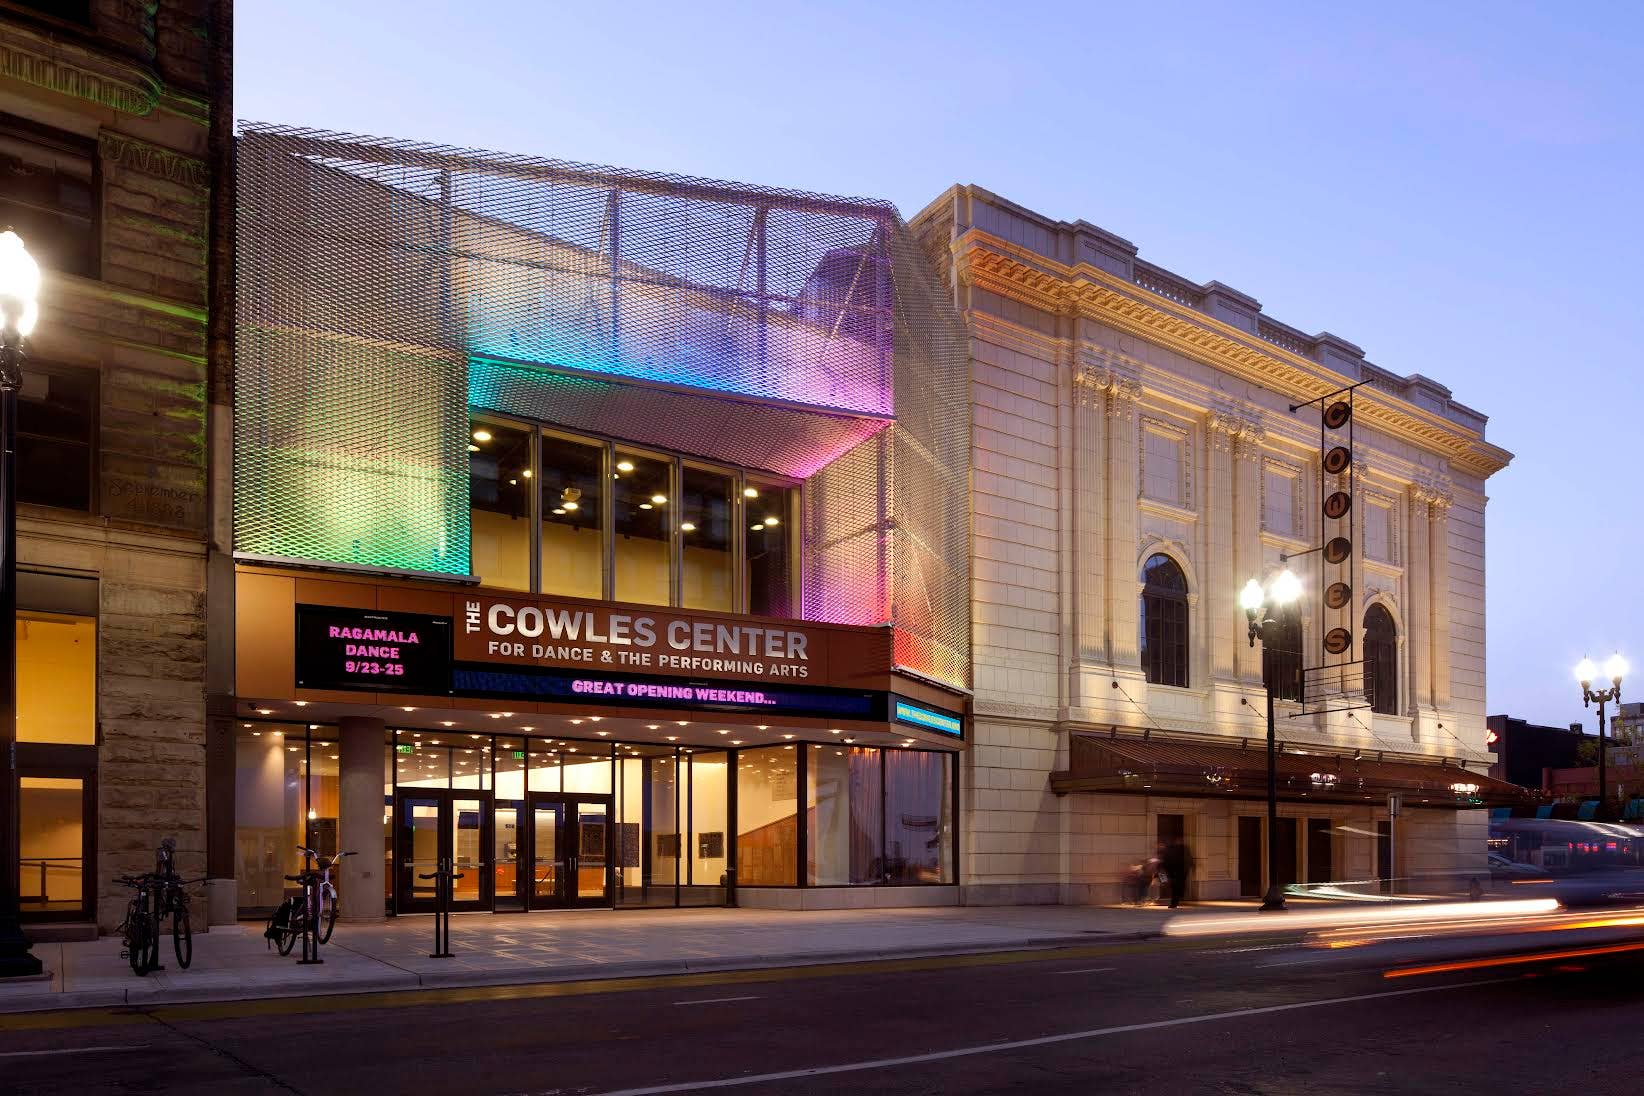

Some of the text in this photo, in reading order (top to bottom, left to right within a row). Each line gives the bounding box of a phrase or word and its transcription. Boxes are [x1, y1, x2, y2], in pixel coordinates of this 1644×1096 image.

[1325, 402, 1348, 652] COWLES
[466, 601, 481, 634] THE
[487, 603, 809, 660] COWLES CENTER
[329, 626, 420, 644] RAGAMALA
[345, 644, 400, 659] DANCE
[488, 641, 809, 678] FOR DANCE & THE PERFORMING ARTS
[345, 660, 405, 676] 9/23-25
[571, 680, 777, 705] GREAT OPENING WEEKEND...
